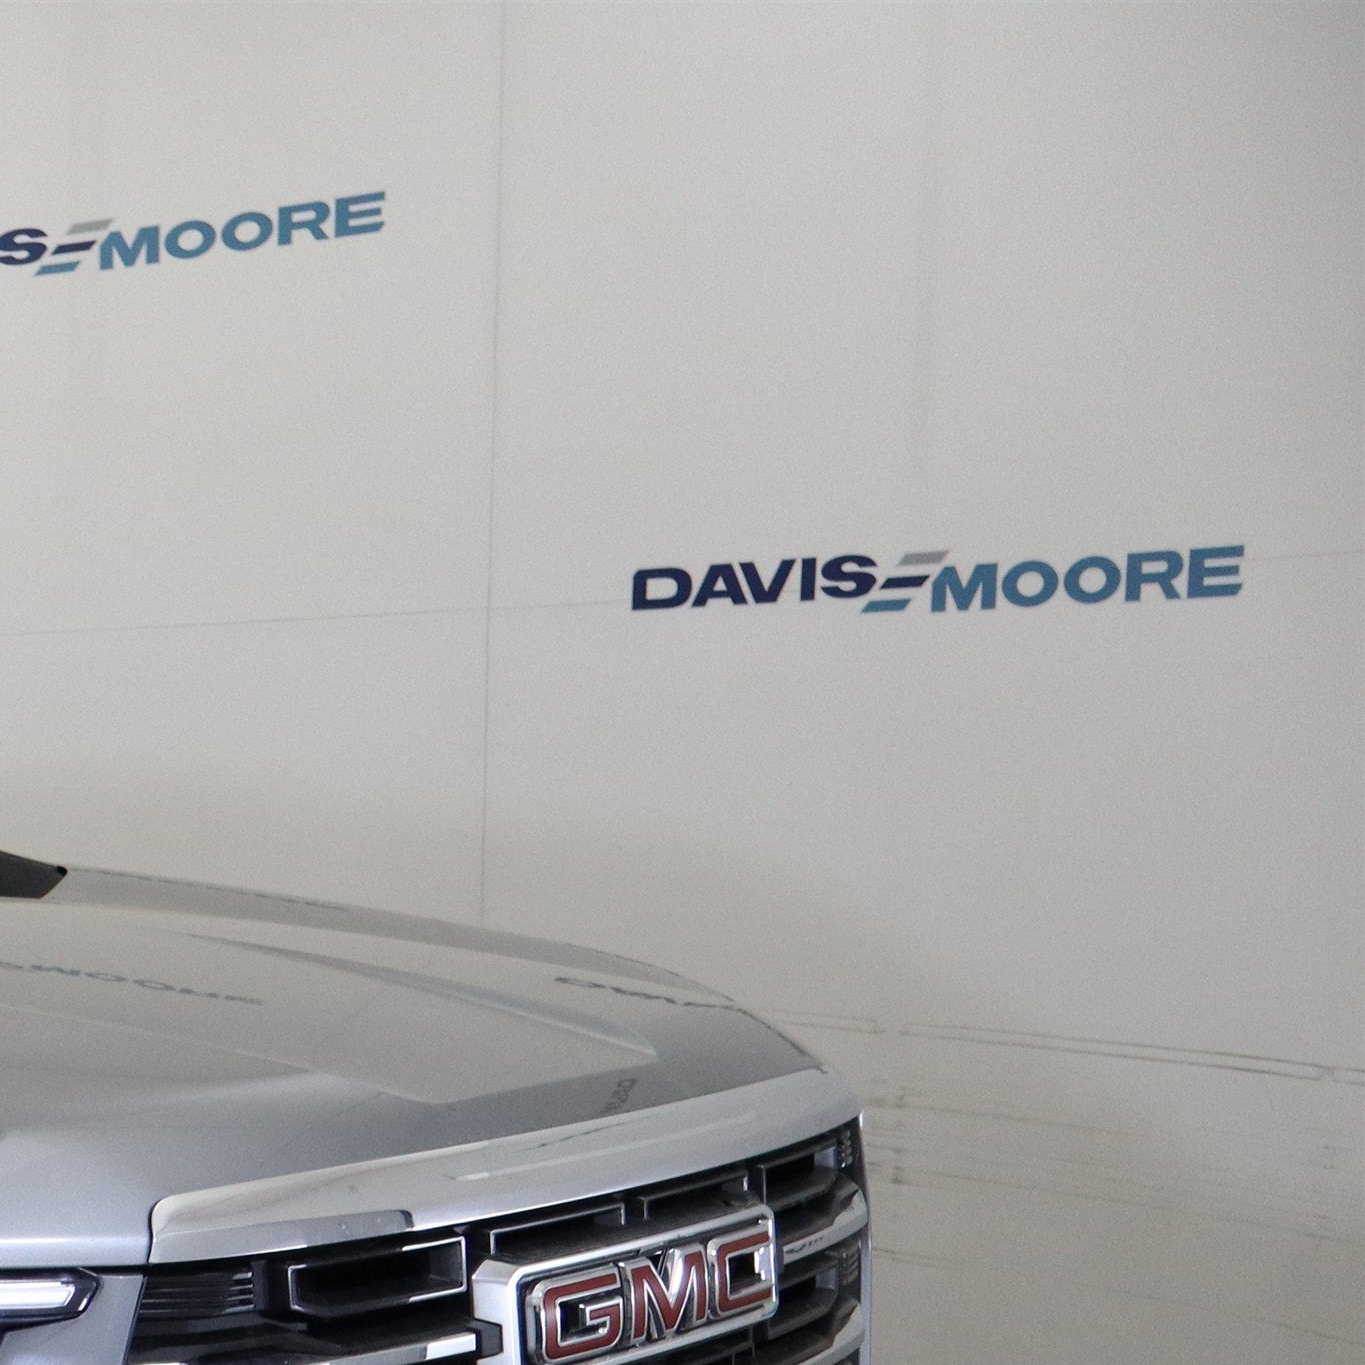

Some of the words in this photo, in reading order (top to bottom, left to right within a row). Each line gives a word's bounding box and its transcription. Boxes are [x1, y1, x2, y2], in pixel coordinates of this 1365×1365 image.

[99, 191, 387, 271] MOORE
[630, 554, 878, 611] DAVIS
[929, 545, 1245, 613] MOORE
[536, 1230, 774, 1365] GMC
